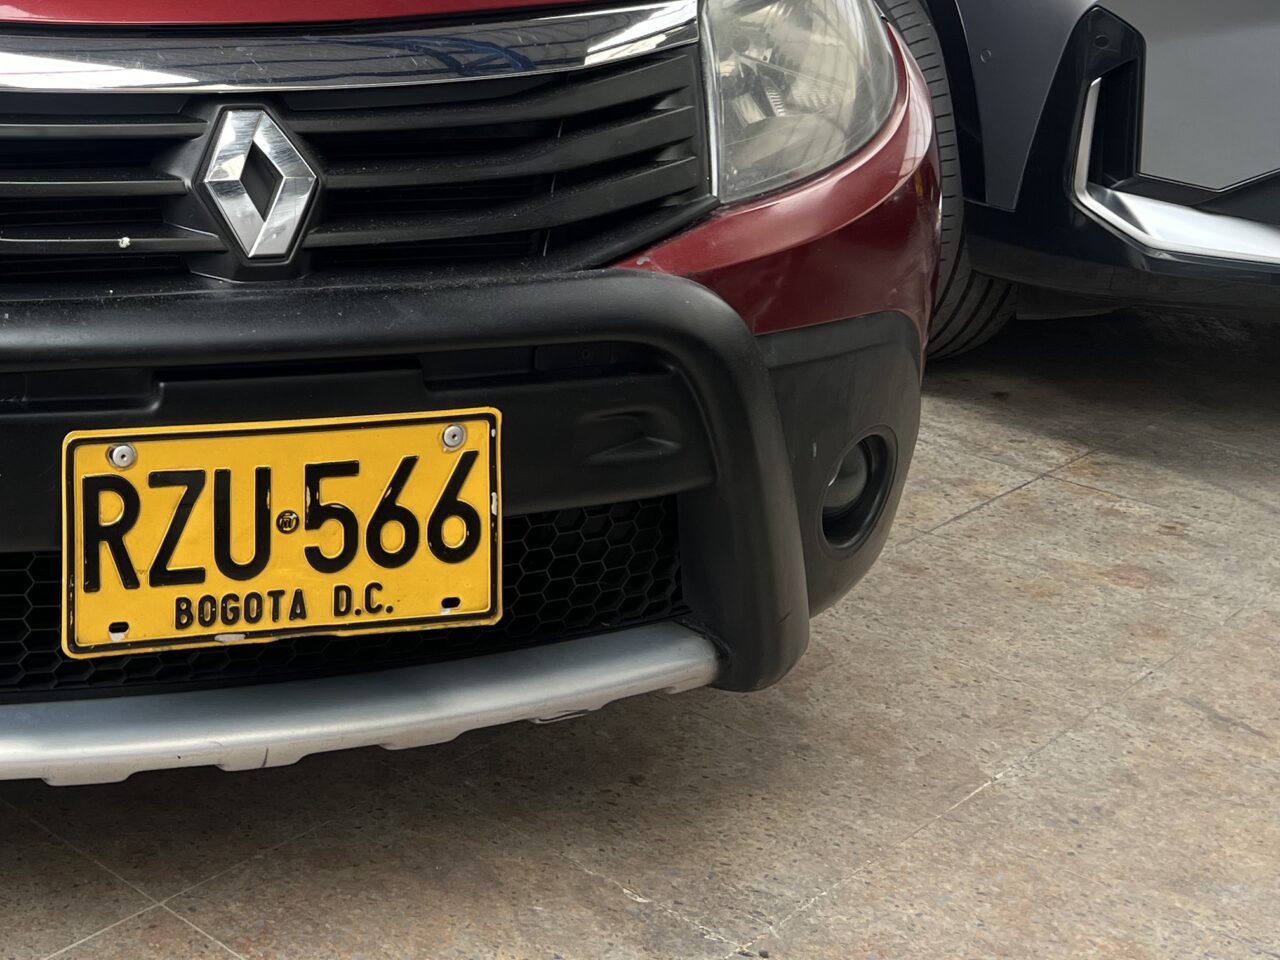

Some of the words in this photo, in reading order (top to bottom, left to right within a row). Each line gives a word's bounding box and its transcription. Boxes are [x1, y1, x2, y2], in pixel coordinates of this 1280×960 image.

[81, 465, 271, 593] RZU
[304, 450, 481, 574] 566
[174, 589, 308, 630] BOGOTA
[333, 582, 394, 617] D.C.
